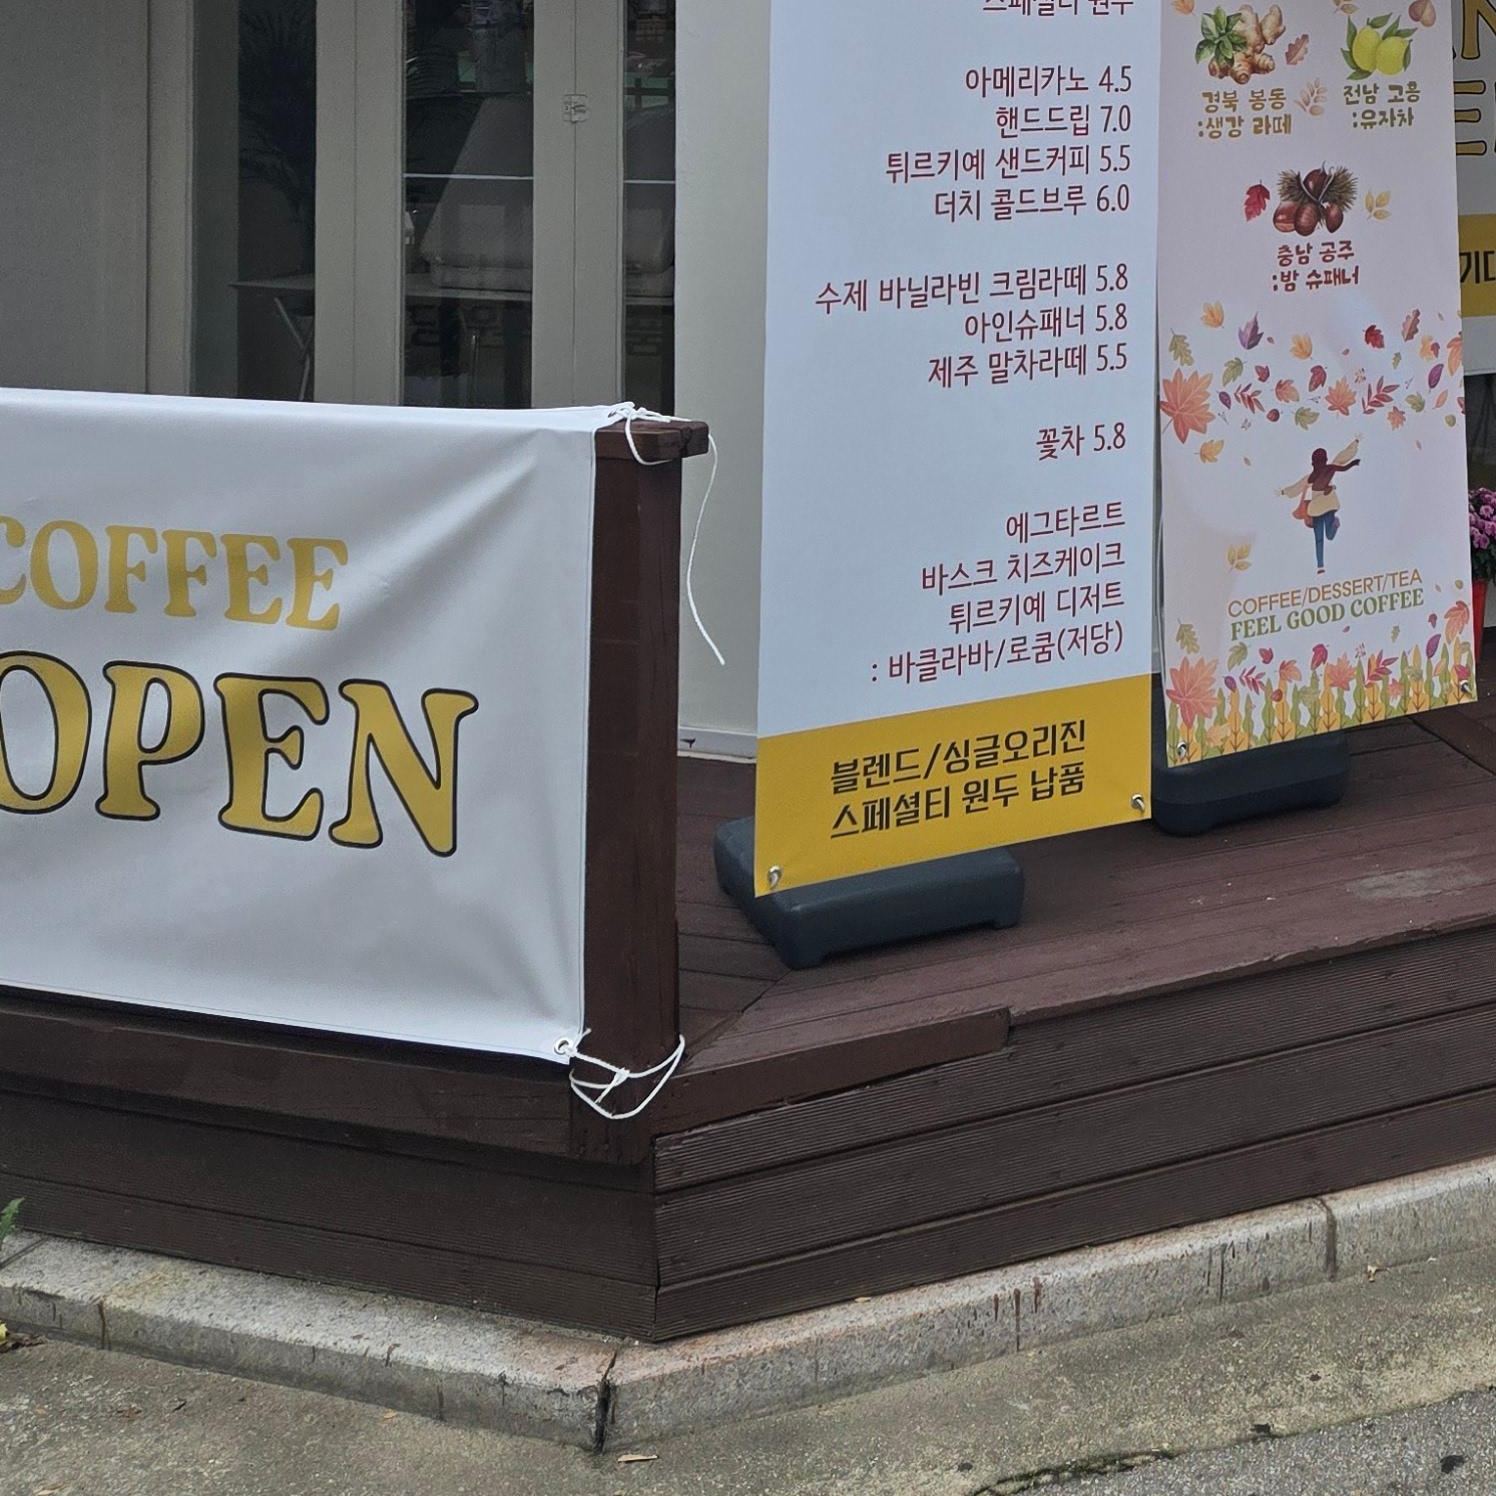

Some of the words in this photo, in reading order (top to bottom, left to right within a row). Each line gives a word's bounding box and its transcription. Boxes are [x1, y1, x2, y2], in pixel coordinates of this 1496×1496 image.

[965, 65, 1089, 98] 아메리카노
[1098, 65, 1132, 93] 4.5
[1202, 91, 1239, 114] 경북
[1248, 87, 1287, 111] 봉동
[1343, 83, 1379, 105] 전남
[995, 104, 1089, 139] 핸드드립
[1100, 104, 1131, 133] 7.0
[1252, 113, 1292, 135] 라떼
[886, 148, 985, 184] 튀르키예
[995, 144, 1089, 179] 샌드커피
[1099, 144, 1131, 172] 5.5
[935, 189, 981, 223] 더치
[990, 185, 1087, 221] 콜드브루
[1096, 183, 1130, 212] 6.0
[1277, 243, 1313, 267] 충남
[1319, 240, 1354, 263] 공주
[815, 279, 867, 315] 수제
[879, 271, 980, 309] 바닐라빈
[989, 264, 1087, 300] 크림라떼
[1095, 263, 1128, 292] 5.8
[1305, 265, 1359, 290] 슈패너
[965, 304, 1085, 344] 아인슈패너
[1095, 303, 1128, 332] 5.8
[928, 355, 979, 388] 제주
[988, 344, 1087, 385] 말차라떼
[1096, 343, 1128, 372] 5.5
[1036, 424, 1085, 461] 꽃차
[1093, 422, 1126, 452] 5.8
[1006, 501, 1125, 544] 에그타르트
[922, 559, 998, 596] 바스크
[1007, 542, 1125, 584] 치즈케이크
[949, 590, 1046, 635] 튀르키예
[1057, 581, 1125, 618] 디저트
[1228, 568, 1423, 618] COFFEE/DESSERT/TEA
[1230, 614, 1282, 642] FEEL
[1286, 603, 1345, 630] GOOD
[1350, 588, 1424, 618] COFFEE
[889, 620, 1124, 684] 바클라바/로쿰(저당)
[0, 650, 479, 857] OPEN
[831, 719, 1085, 795] 블렌드/싱글오리진
[831, 785, 950, 839] 스페셜티
[962, 774, 1019, 814] 원두
[1031, 761, 1085, 802] 납품
